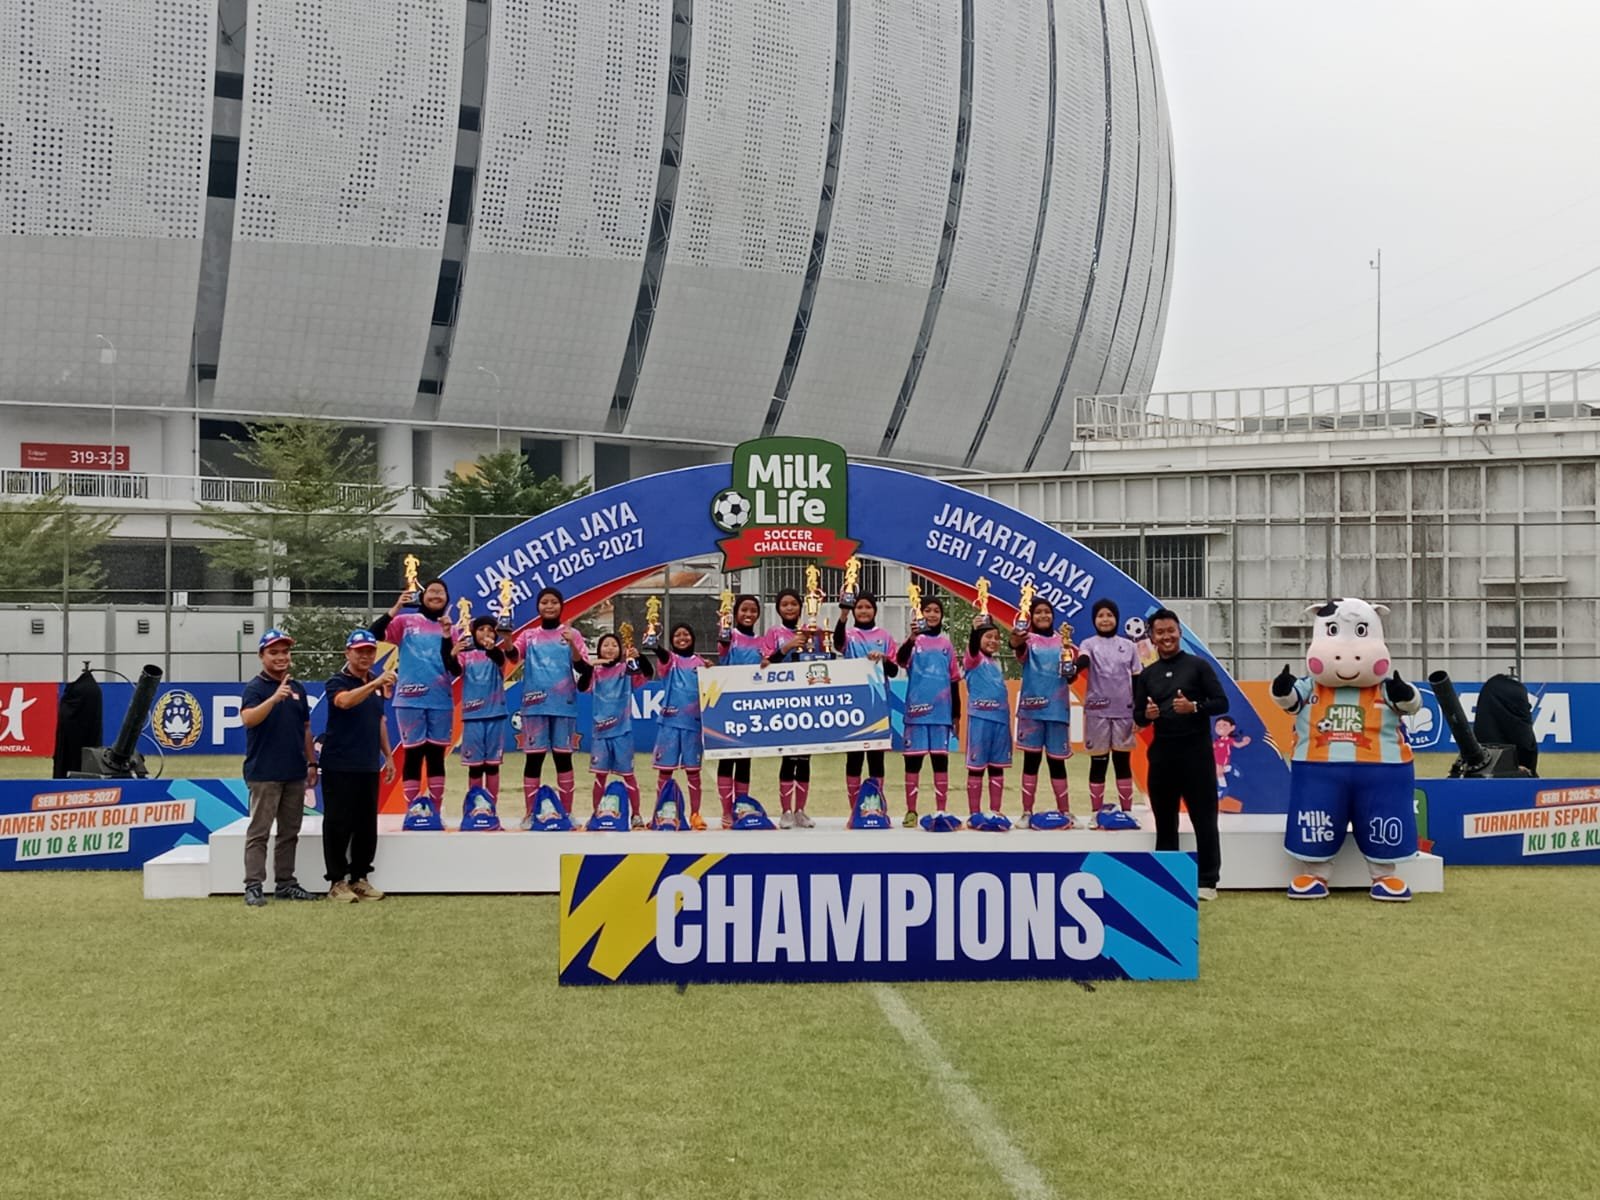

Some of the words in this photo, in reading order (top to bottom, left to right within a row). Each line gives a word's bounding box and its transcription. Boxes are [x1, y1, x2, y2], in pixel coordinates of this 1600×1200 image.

[748, 454, 832, 489] Milk
[755, 489, 826, 524] Life
[753, 542, 824, 552] CHALLENGE
[764, 530, 813, 540] SOCCER
[926, 529, 973, 561] SERI
[975, 549, 988, 567] 1
[475, 526, 576, 598] JAKARTA
[579, 501, 638, 542] JAYA
[933, 503, 1037, 565] JAKARTA
[1037, 552, 1095, 599] JAYA
[486, 579, 532, 618] SRI
[531, 572, 546, 590] 1
[548, 528, 645, 584] 2026-2027
[767, 670, 795, 682] BCA
[732, 696, 811, 711] CHAMPION
[814, 694, 834, 706] KU
[837, 693, 853, 705] 12
[1329, 706, 1361, 720] Milk
[725, 721, 747, 736] Rp
[749, 709, 865, 732] 3.600.000
[1333, 719, 1362, 733] Life
[50, 812, 98, 831] SEPAK
[102, 807, 139, 826] BOLA
[143, 803, 186, 823] PUTRI
[1297, 810, 1334, 827] Milk
[1473, 811, 1550, 834] TURNAMEN
[1554, 807, 1598, 827] SEPAK
[22, 838, 42, 857] KU
[46, 837, 63, 854] 10
[67, 835, 77, 853] &
[83, 833, 103, 851] KU
[107, 832, 124, 849] 12
[1301, 826, 1335, 843] Life
[1369, 817, 1403, 846] 10
[1527, 834, 1546, 852] KU
[1551, 832, 1566, 849] 10
[1570, 830, 1580, 847] &
[655, 872, 1104, 964] CHAMPIONS
